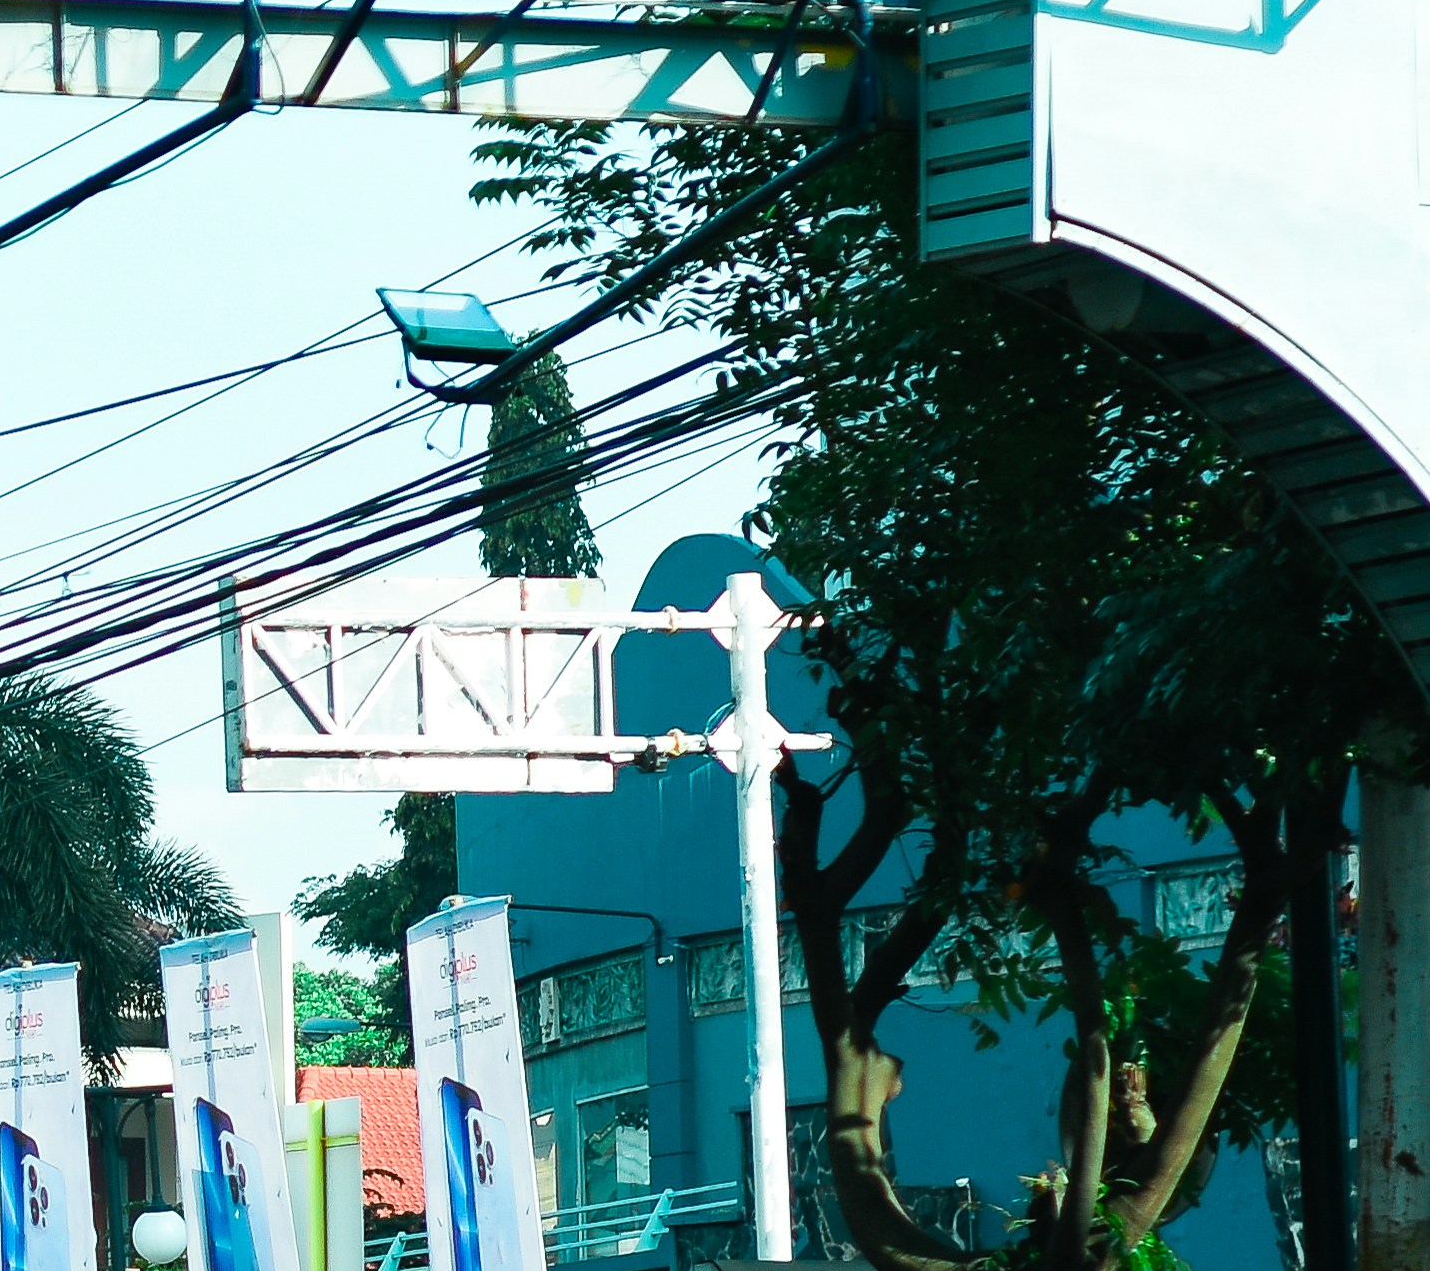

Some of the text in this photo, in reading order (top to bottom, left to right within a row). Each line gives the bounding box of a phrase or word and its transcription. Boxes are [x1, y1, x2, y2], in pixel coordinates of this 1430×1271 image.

[439, 948, 478, 983] digiplus
[195, 975, 231, 1008] digiplus
[5, 1004, 44, 1036] digiplus
